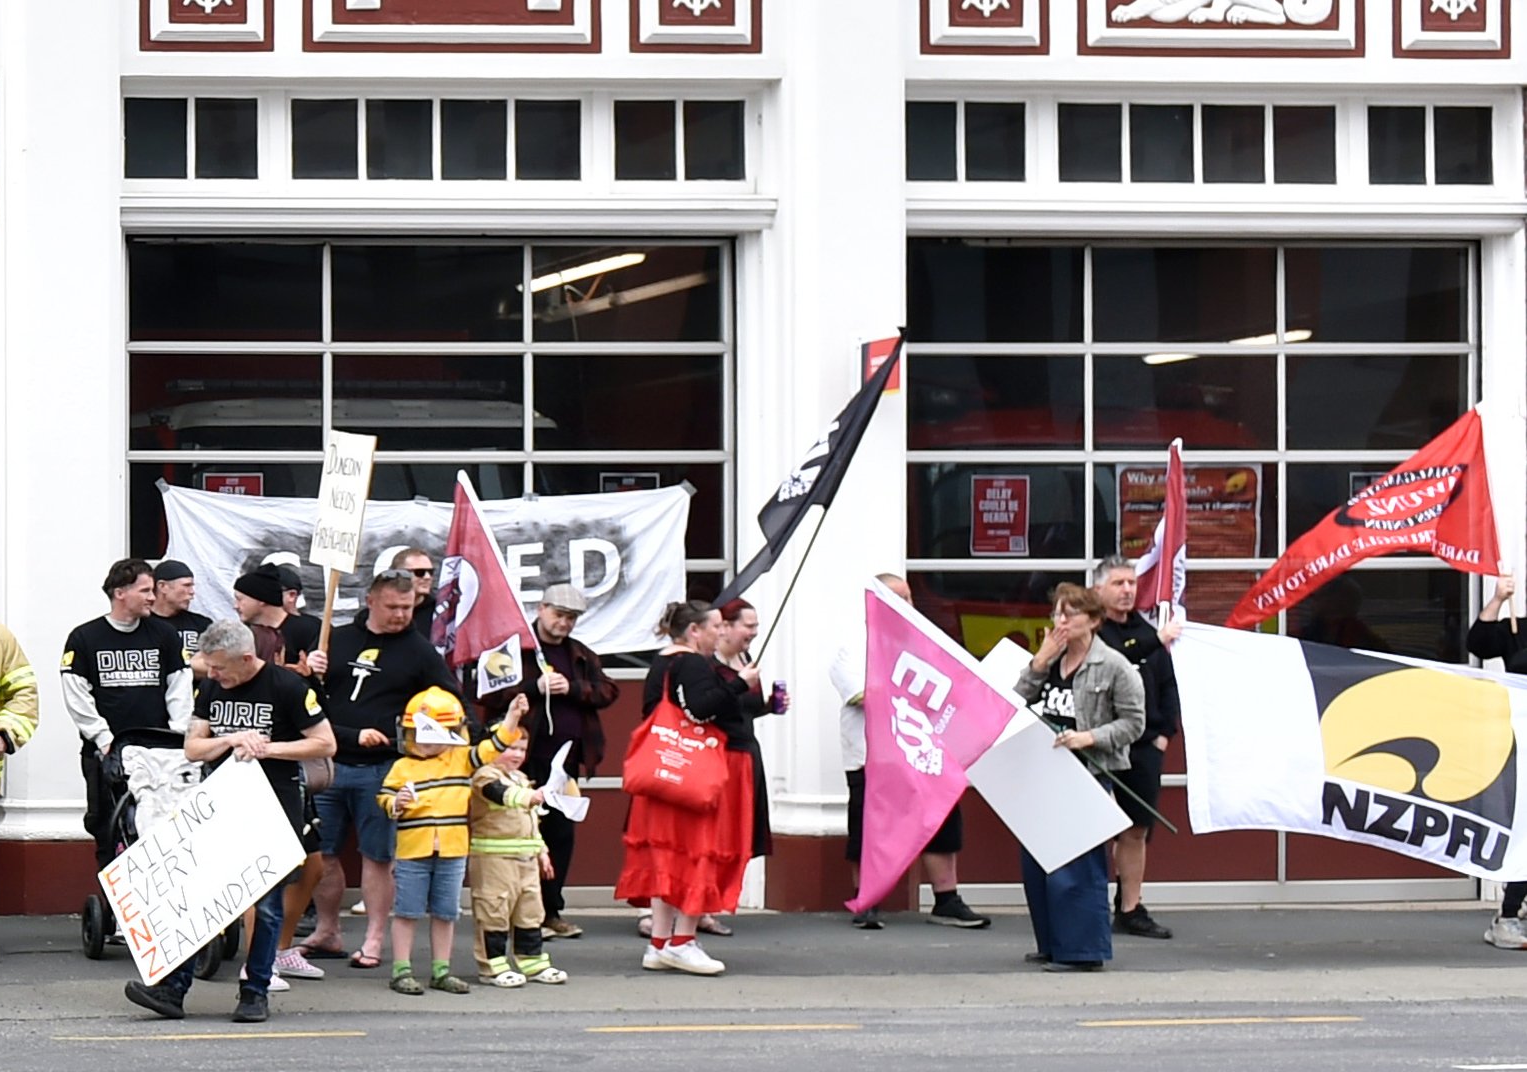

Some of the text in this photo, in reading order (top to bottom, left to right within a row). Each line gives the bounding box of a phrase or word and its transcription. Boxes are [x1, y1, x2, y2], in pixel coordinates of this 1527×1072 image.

[1127, 472, 1155, 485] Why
[97, 649, 160, 671] DIRE
[106, 791, 216, 896] FAILING
[1321, 780, 1510, 872] NZPFU
[118, 841, 198, 923] EVERY
[130, 884, 188, 951] NEW
[140, 855, 278, 979] ZEALANDER
